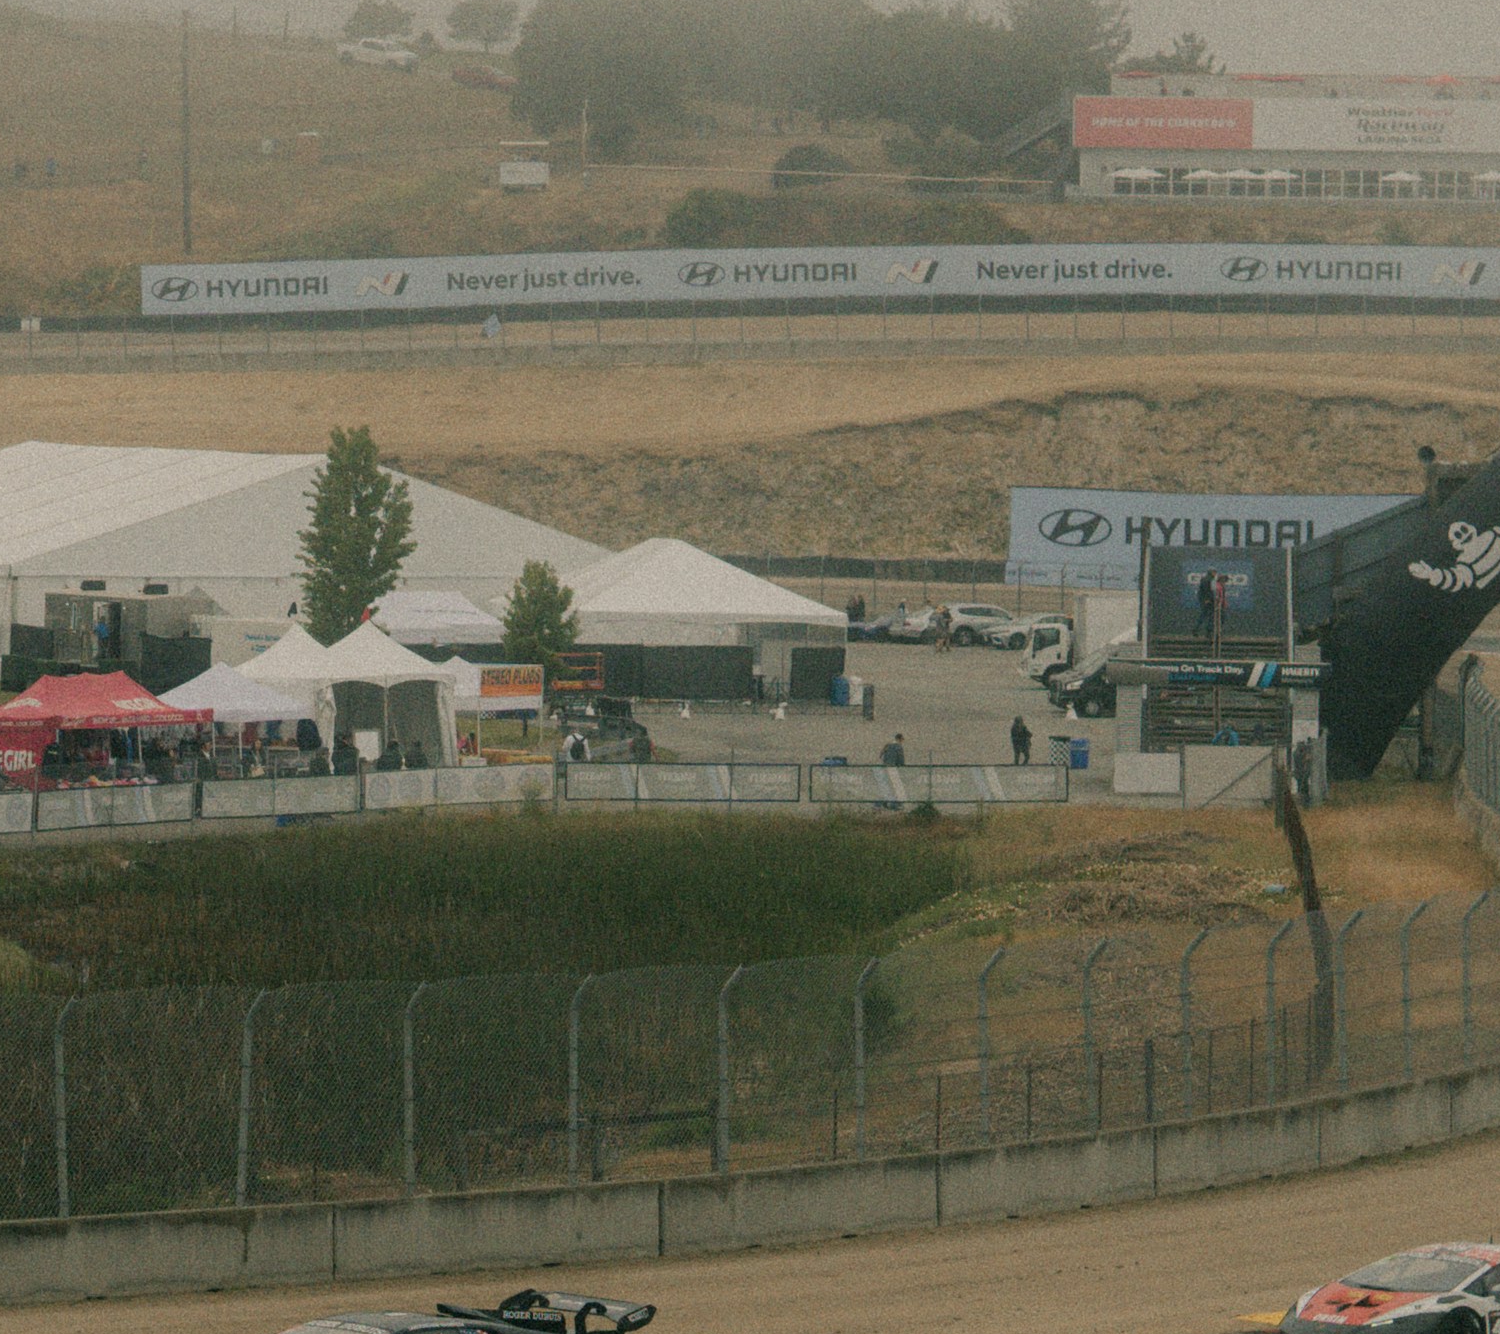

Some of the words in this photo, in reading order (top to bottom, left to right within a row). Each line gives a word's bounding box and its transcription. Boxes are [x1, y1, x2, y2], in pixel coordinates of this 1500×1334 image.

[447, 271, 517, 291] Never
[523, 268, 567, 292] just
[574, 266, 641, 286] drive.
[734, 262, 858, 283] HYUNDAI
[977, 261, 1048, 280] Never
[1054, 259, 1098, 283] just
[1104, 259, 1172, 280] drive.
[1277, 260, 1401, 281] HYUNDAI
[207, 276, 328, 298] HYUNDAI
[1125, 516, 1315, 548] HYUNDAI
[503, 1310, 531, 1320] ROGER
